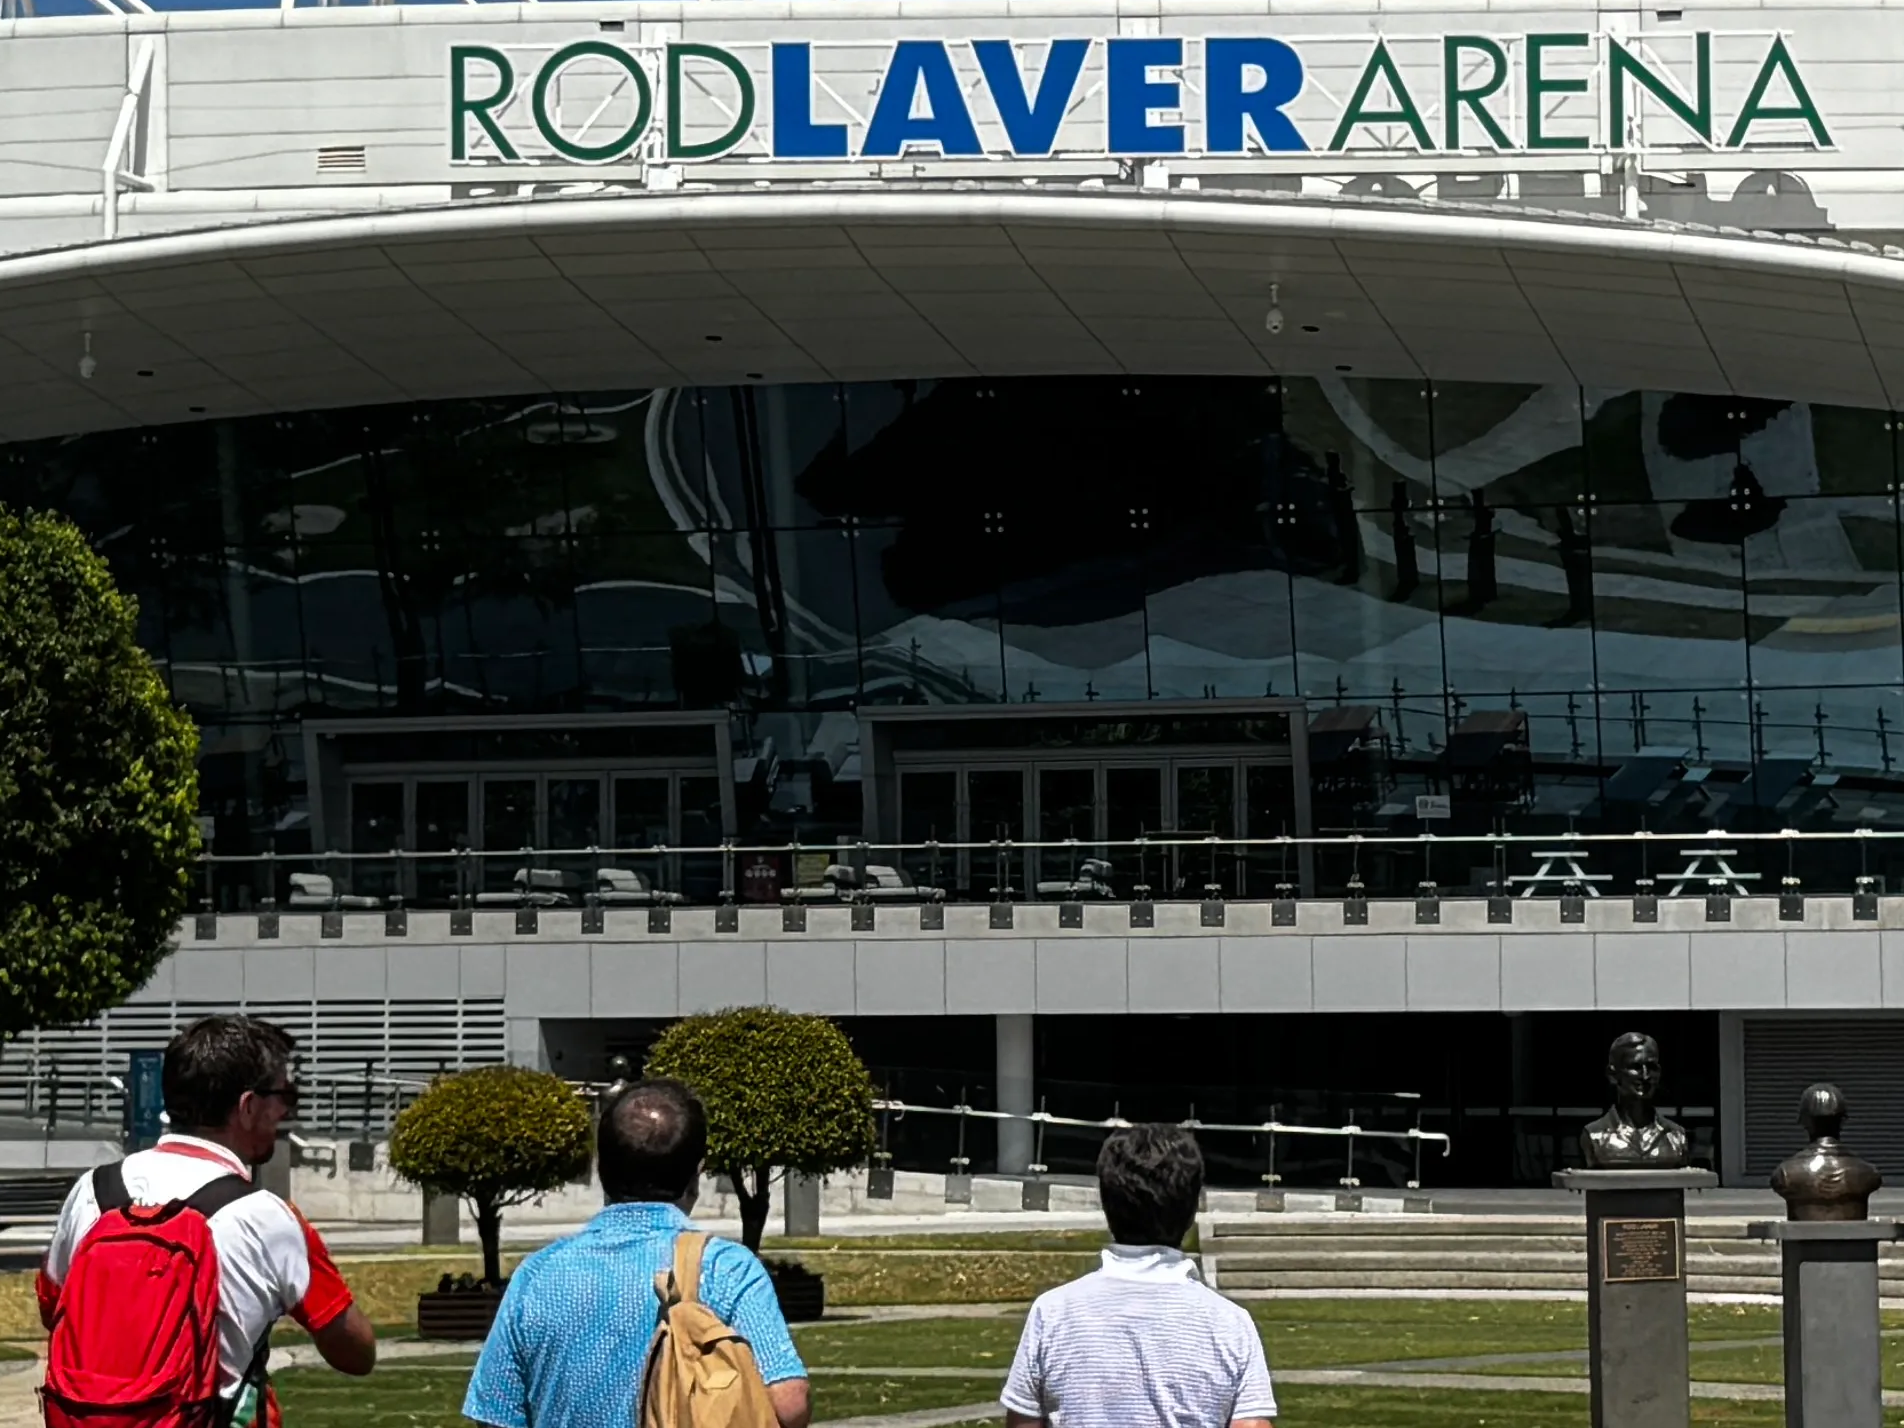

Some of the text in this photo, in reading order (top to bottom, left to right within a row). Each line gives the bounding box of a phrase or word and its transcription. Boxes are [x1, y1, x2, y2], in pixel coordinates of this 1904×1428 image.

[449, 32, 1836, 162] ROD LAVER ARENA
